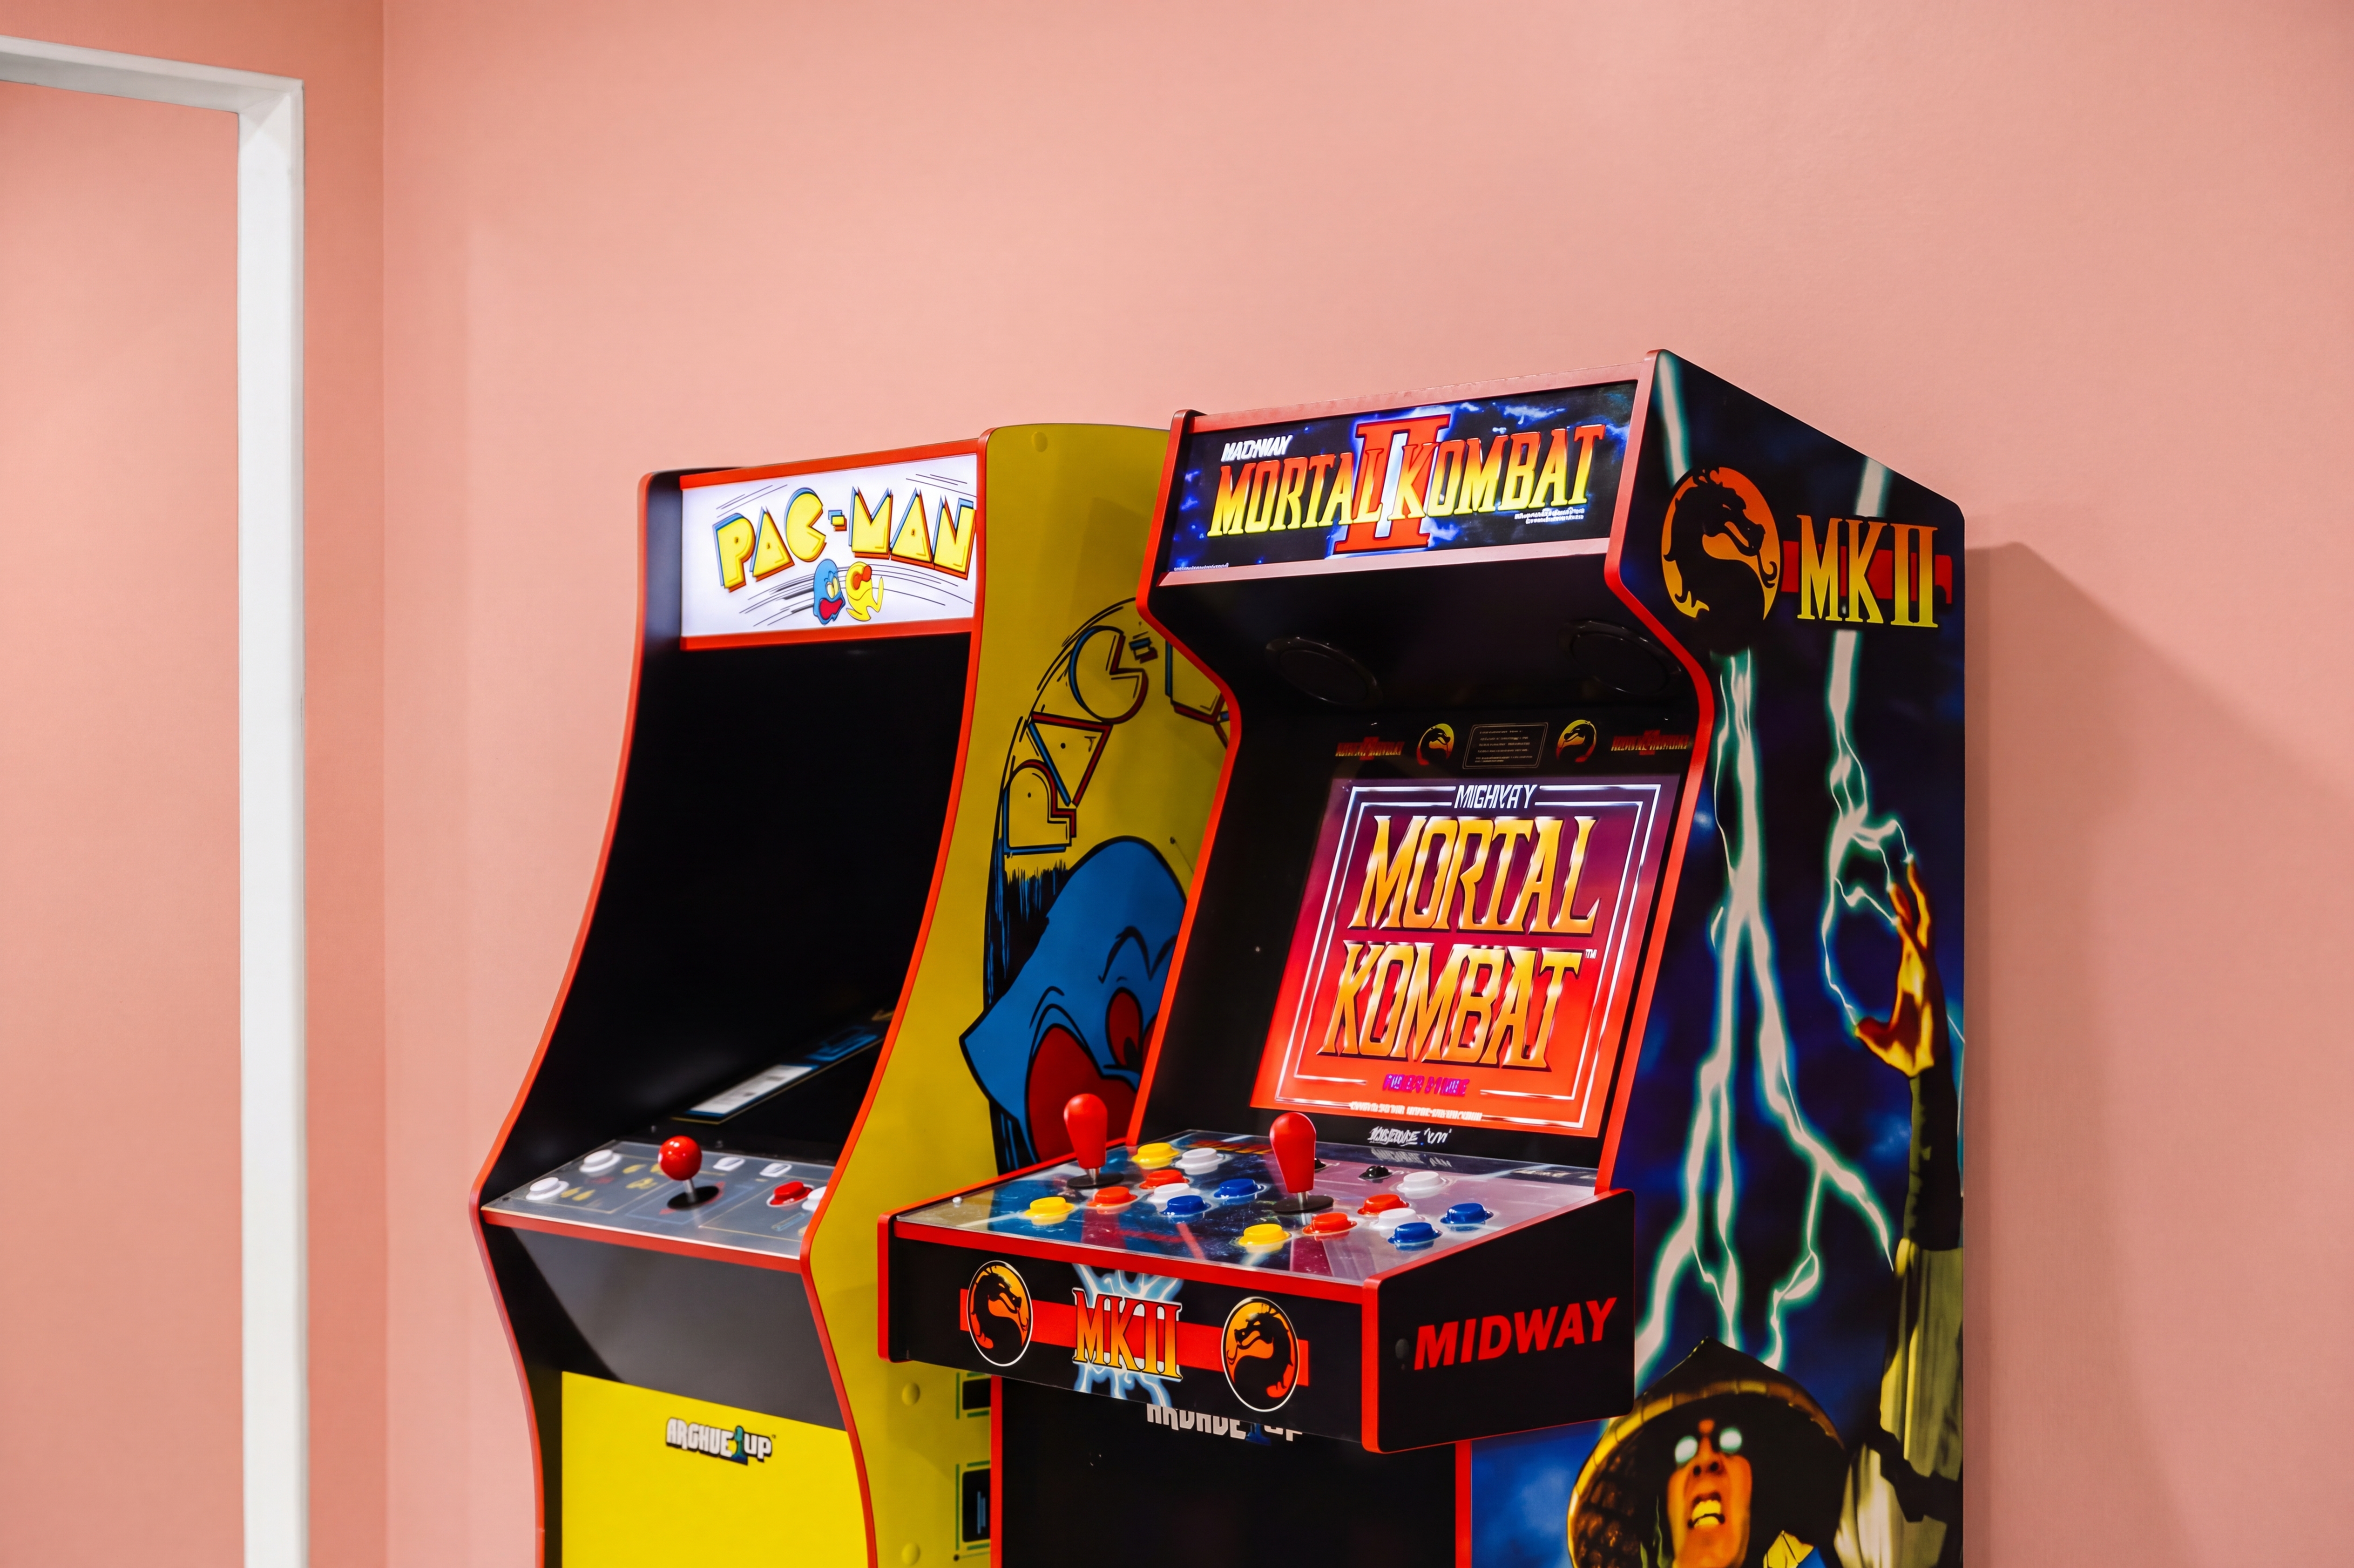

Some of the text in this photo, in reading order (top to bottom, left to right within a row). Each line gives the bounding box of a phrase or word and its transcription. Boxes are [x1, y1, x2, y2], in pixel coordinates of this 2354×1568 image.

[1207, 451, 1383, 536] MORTAL
[1387, 425, 1606, 521] KOMBAT
[713, 487, 976, 593] PAC-MAN
[1347, 815, 1601, 936] MORTAL
[1316, 939, 1583, 1071] KOMBAT
[1414, 1297, 1617, 1371] MIDWAY
